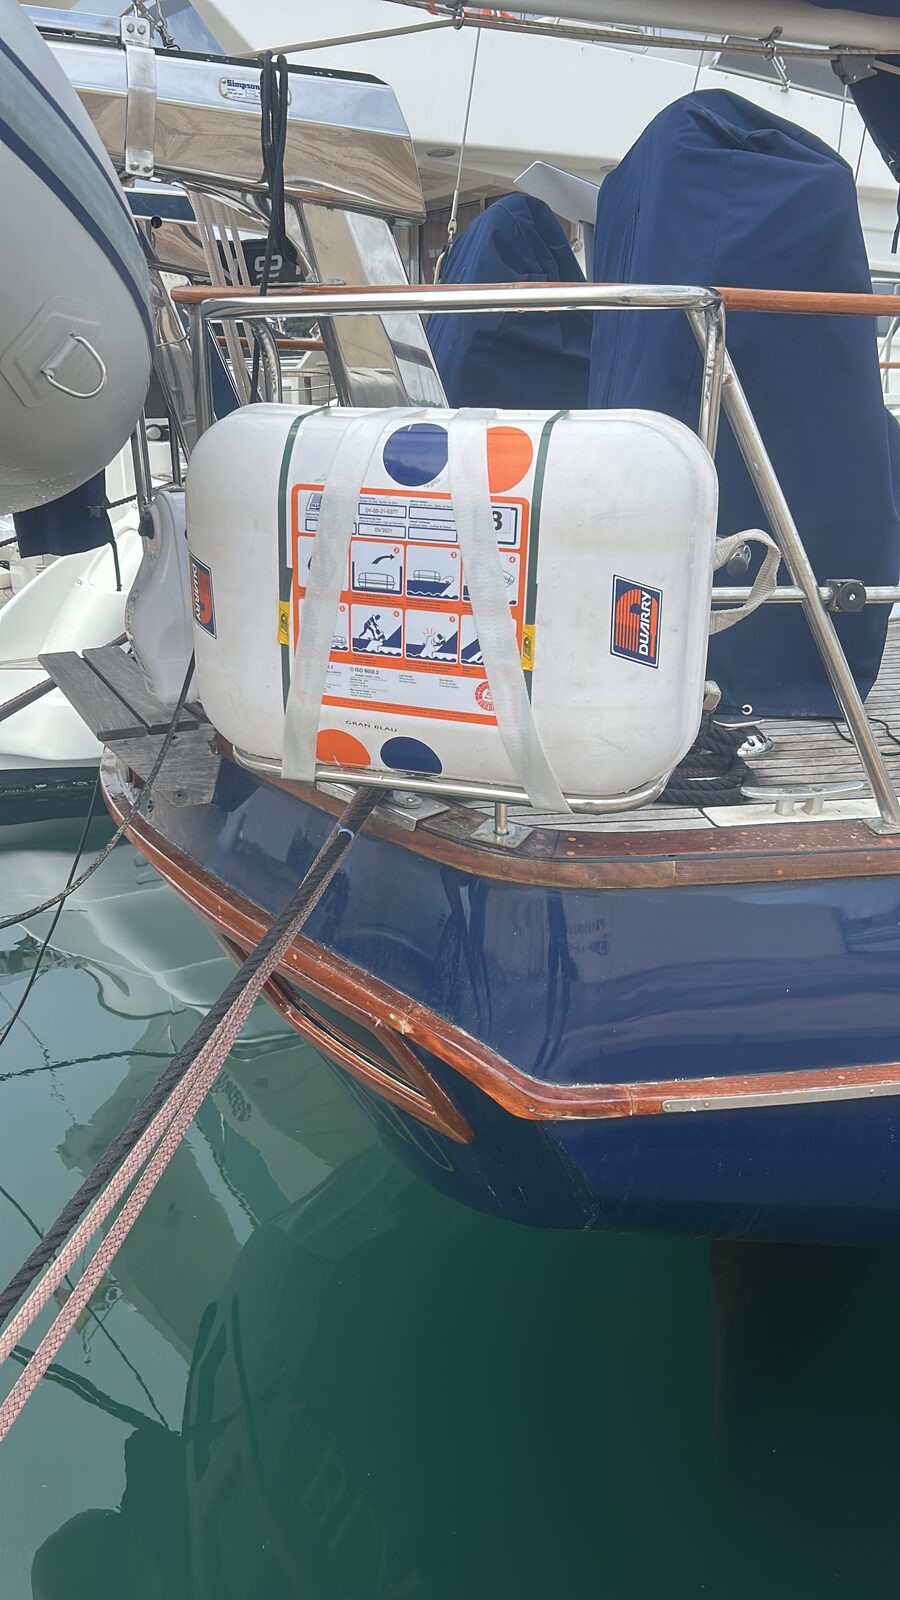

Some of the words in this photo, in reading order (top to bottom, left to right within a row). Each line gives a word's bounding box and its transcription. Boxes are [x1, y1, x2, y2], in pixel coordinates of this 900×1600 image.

[226, 79, 260, 90] Simpson
[192, 563, 202, 622] DUARRY
[639, 590, 652, 656] DUARRY
[345, 720, 371, 728] GRAN
[374, 725, 398, 733] BLAU
